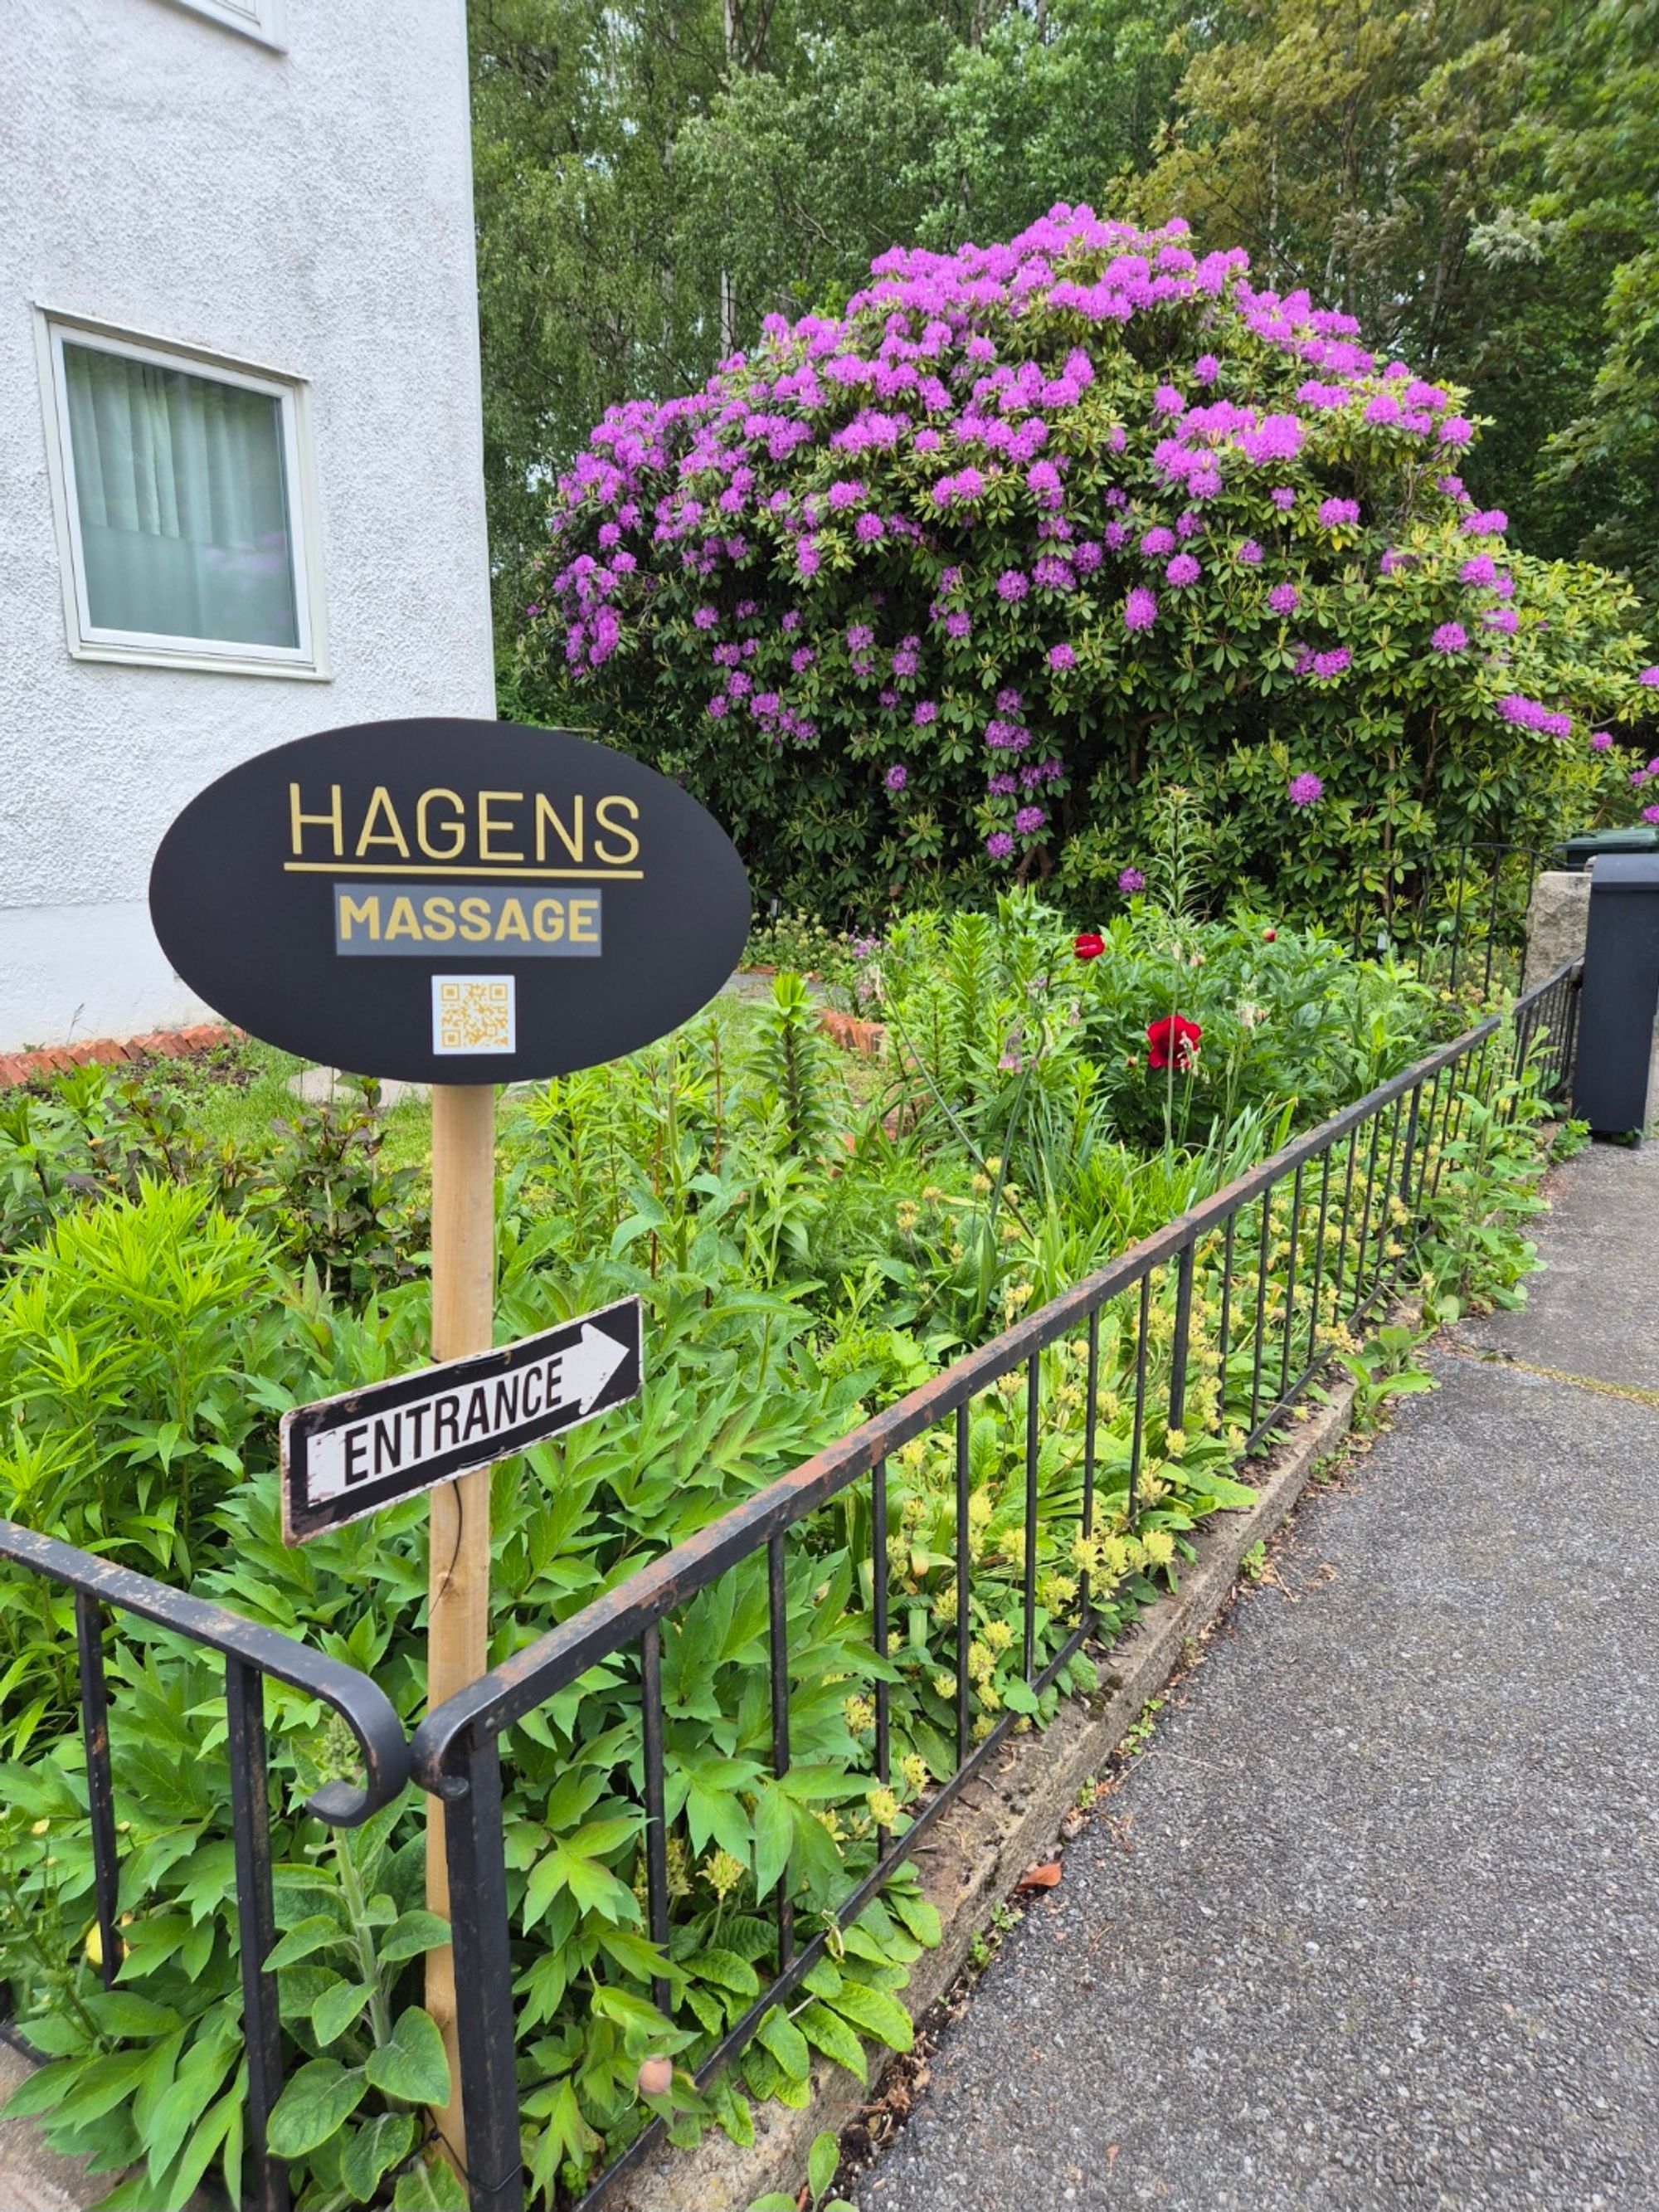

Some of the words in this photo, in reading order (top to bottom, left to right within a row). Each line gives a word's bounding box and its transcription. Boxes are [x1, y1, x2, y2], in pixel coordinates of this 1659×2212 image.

[289, 782, 640, 865] HAGENS
[339, 895, 599, 942] MASSAGE
[345, 1357, 562, 1486] ENTRANCE
